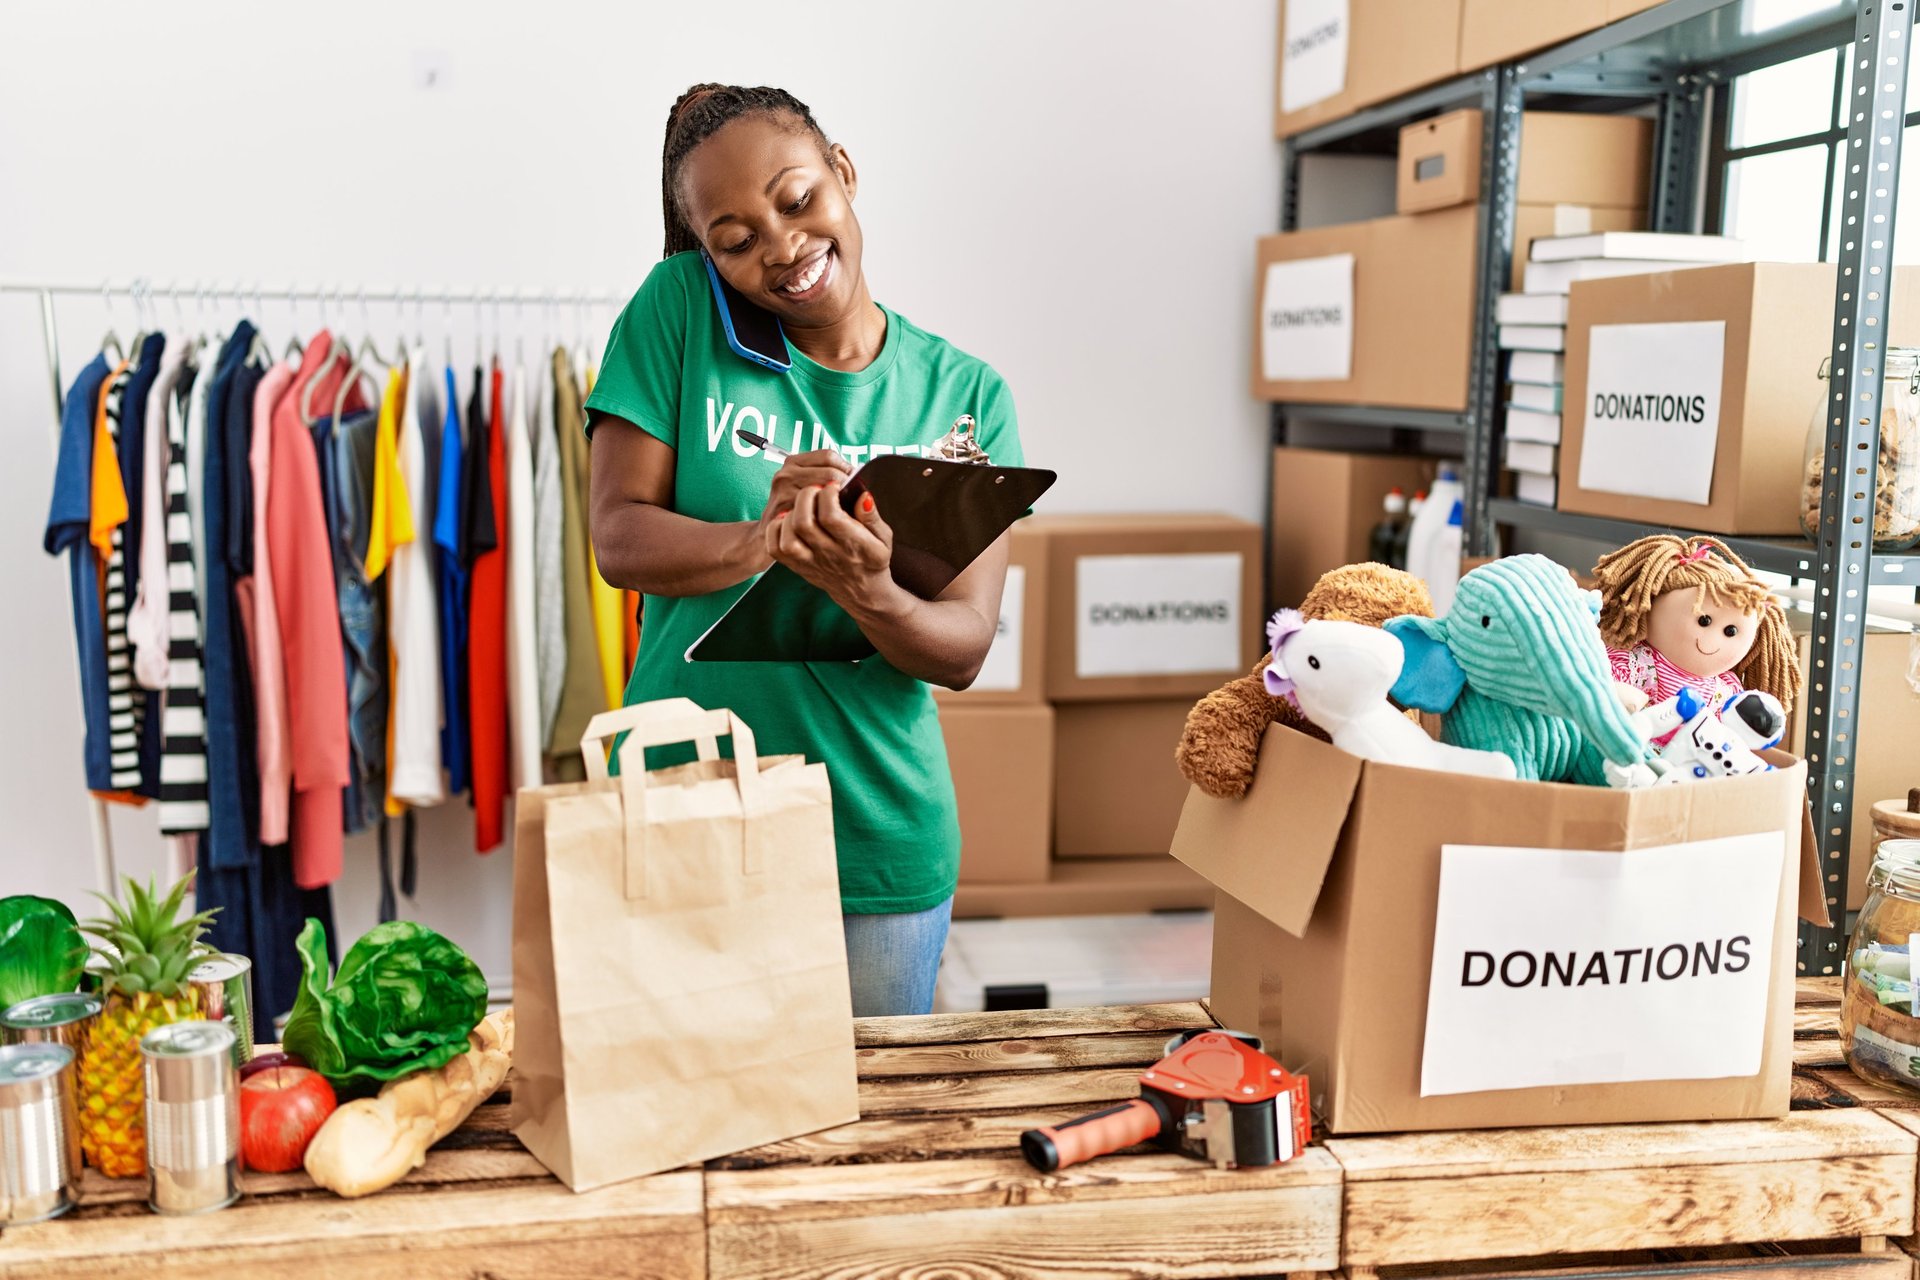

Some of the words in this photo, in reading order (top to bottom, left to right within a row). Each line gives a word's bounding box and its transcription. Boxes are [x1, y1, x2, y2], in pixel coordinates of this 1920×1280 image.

[1594, 393, 1705, 423] DONATIONS
[1089, 602, 1229, 625] DONATIONS
[1461, 935, 1751, 987] DONATIONS
